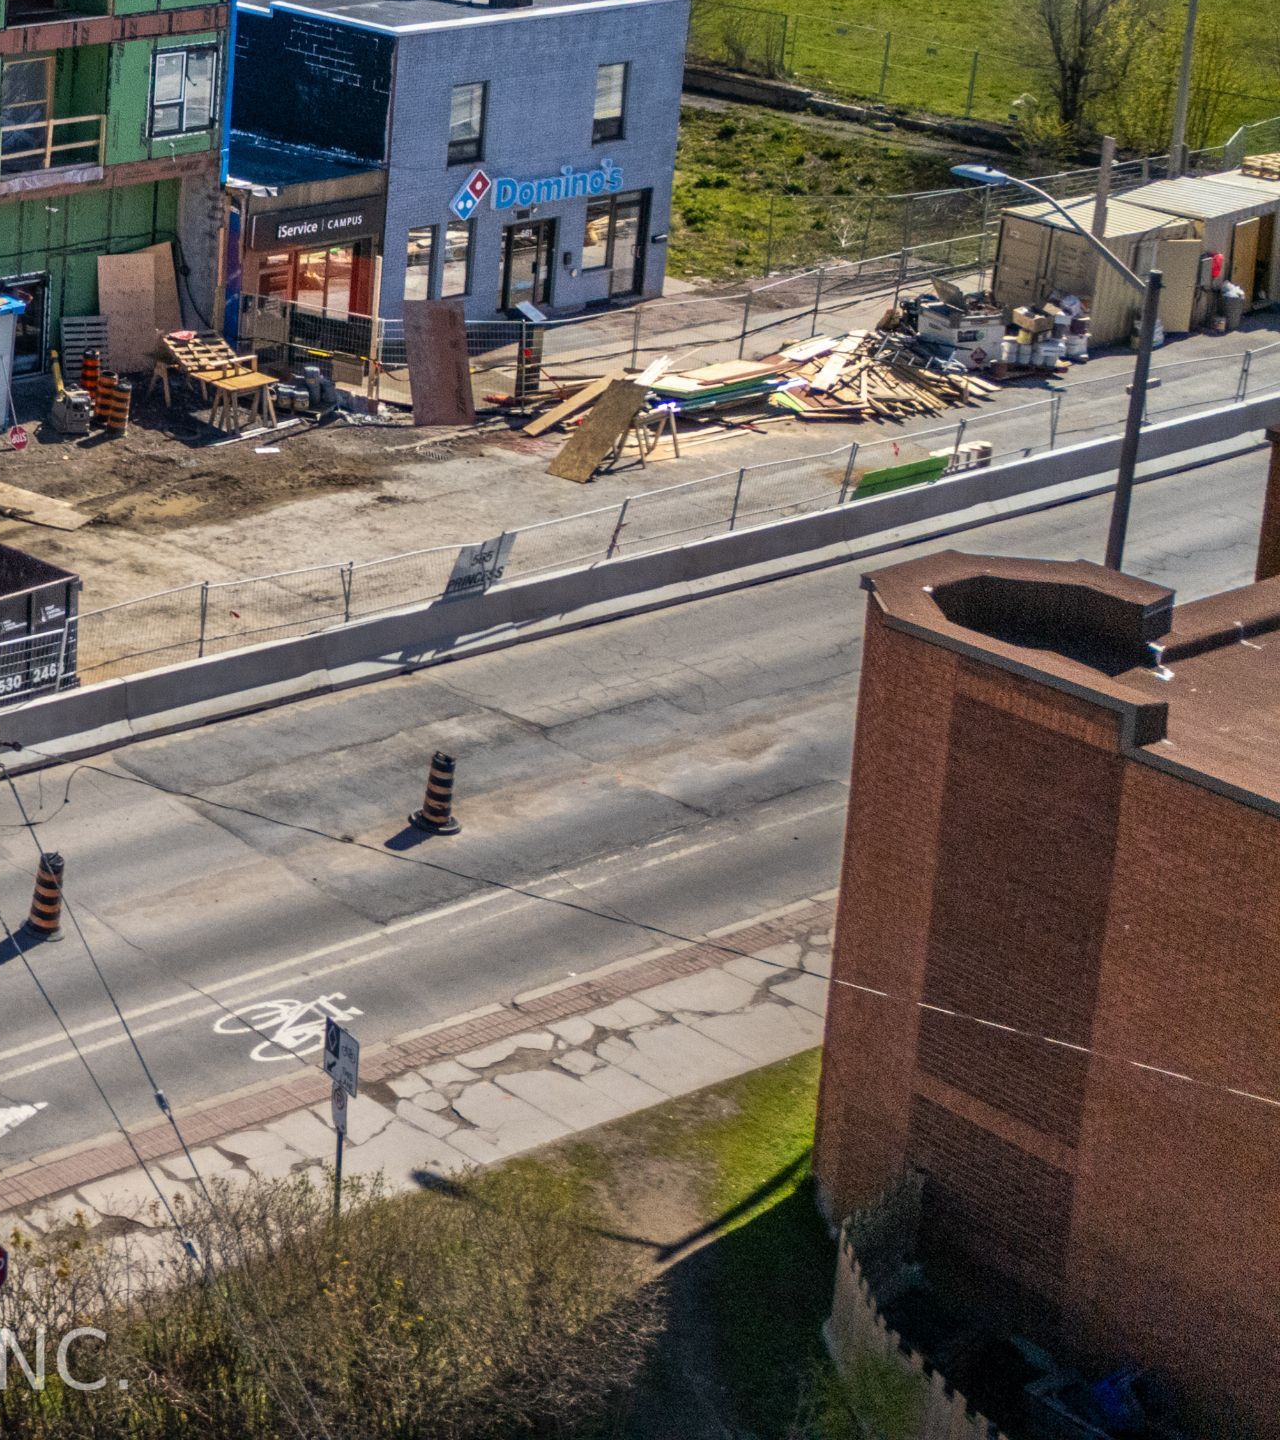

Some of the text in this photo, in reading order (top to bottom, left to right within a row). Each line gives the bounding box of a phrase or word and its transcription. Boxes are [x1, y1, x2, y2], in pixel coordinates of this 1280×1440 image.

[490, 158, 623, 210] Domino's
[278, 215, 363, 238] iService CAMPUS
